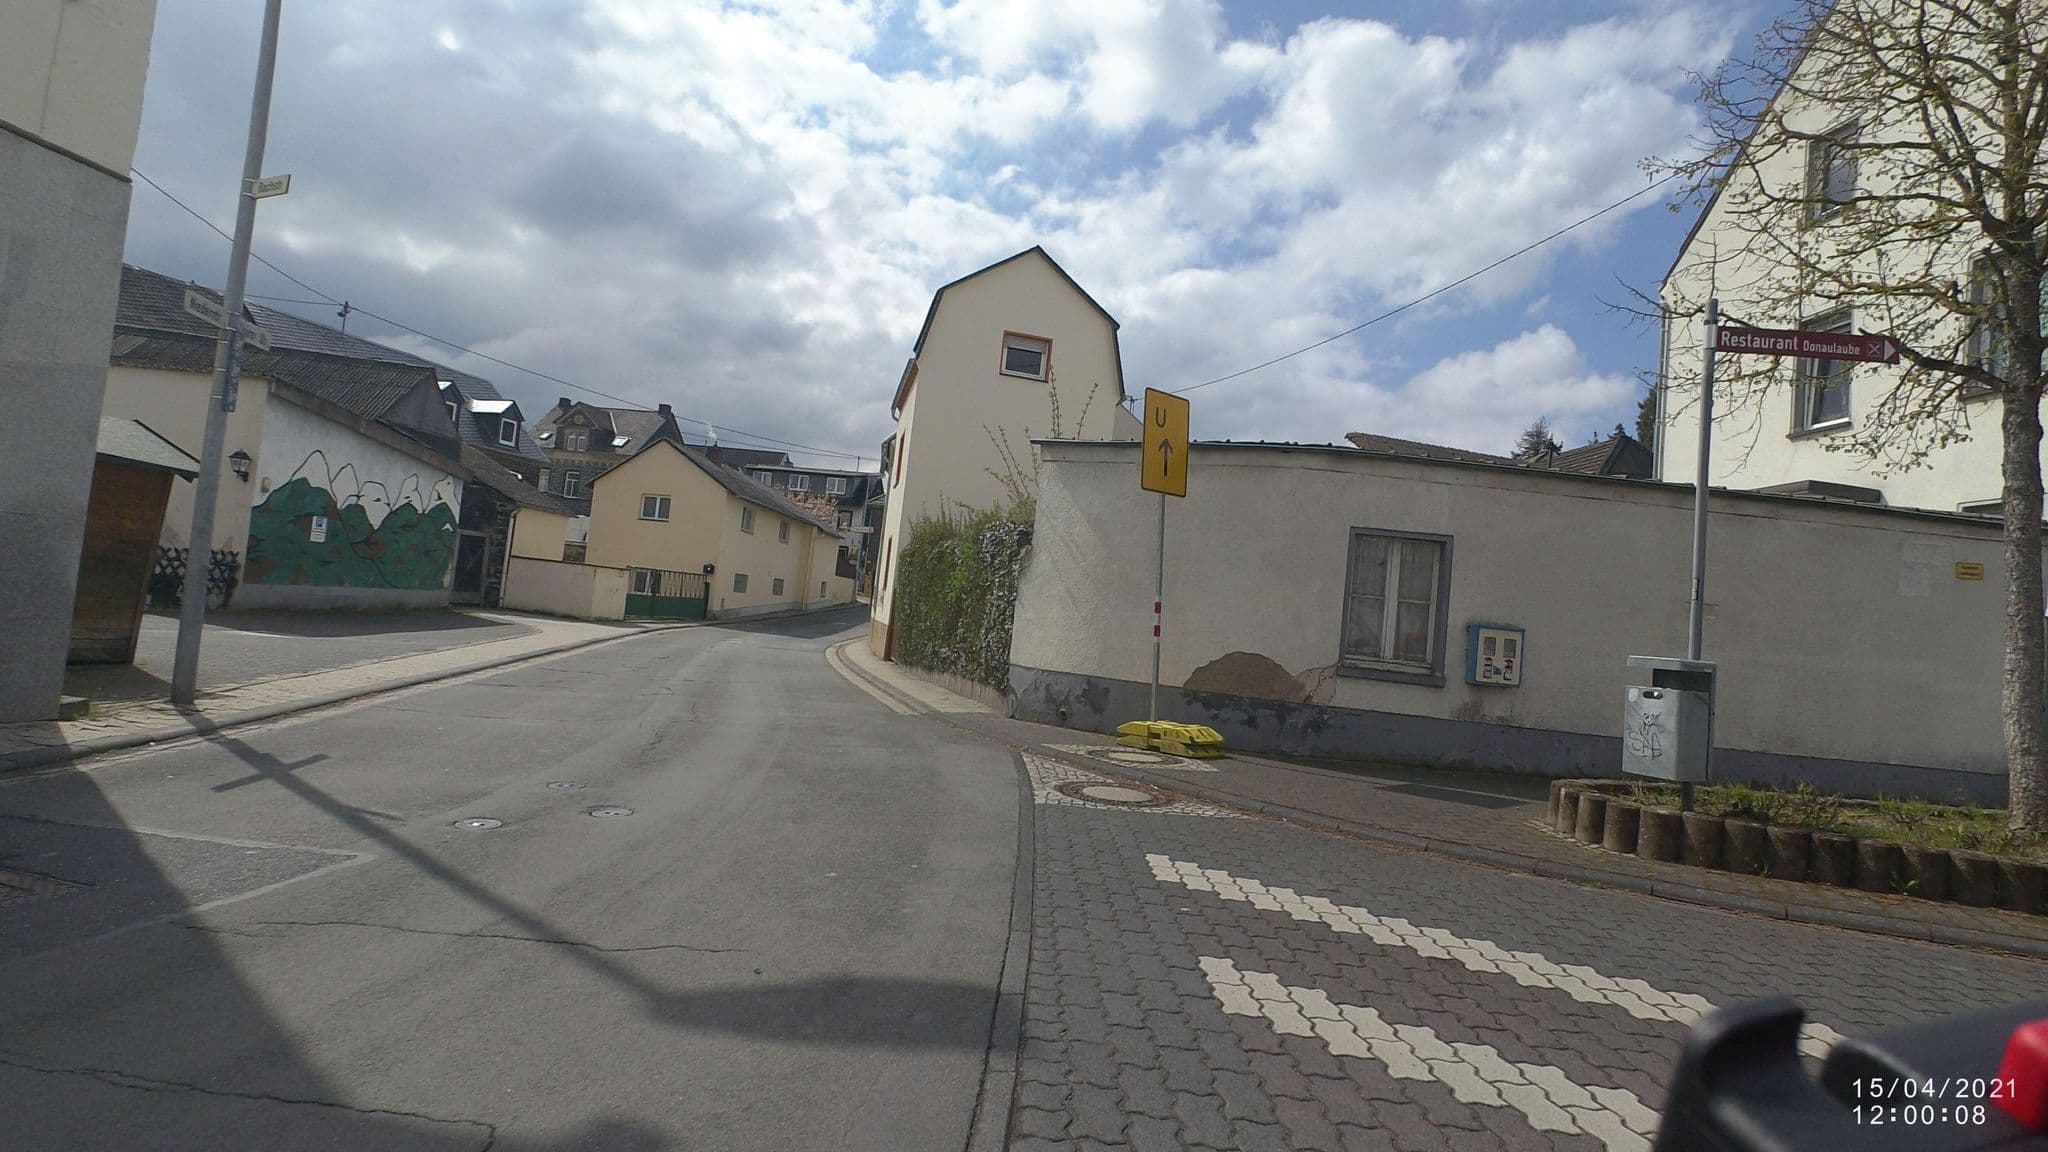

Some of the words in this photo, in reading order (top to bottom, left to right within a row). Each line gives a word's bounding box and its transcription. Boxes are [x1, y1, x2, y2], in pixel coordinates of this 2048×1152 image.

[1720, 330, 1799, 351] Restaurant
[1803, 340, 1861, 355] Donaulaube
[1156, 406, 1166, 427] U
